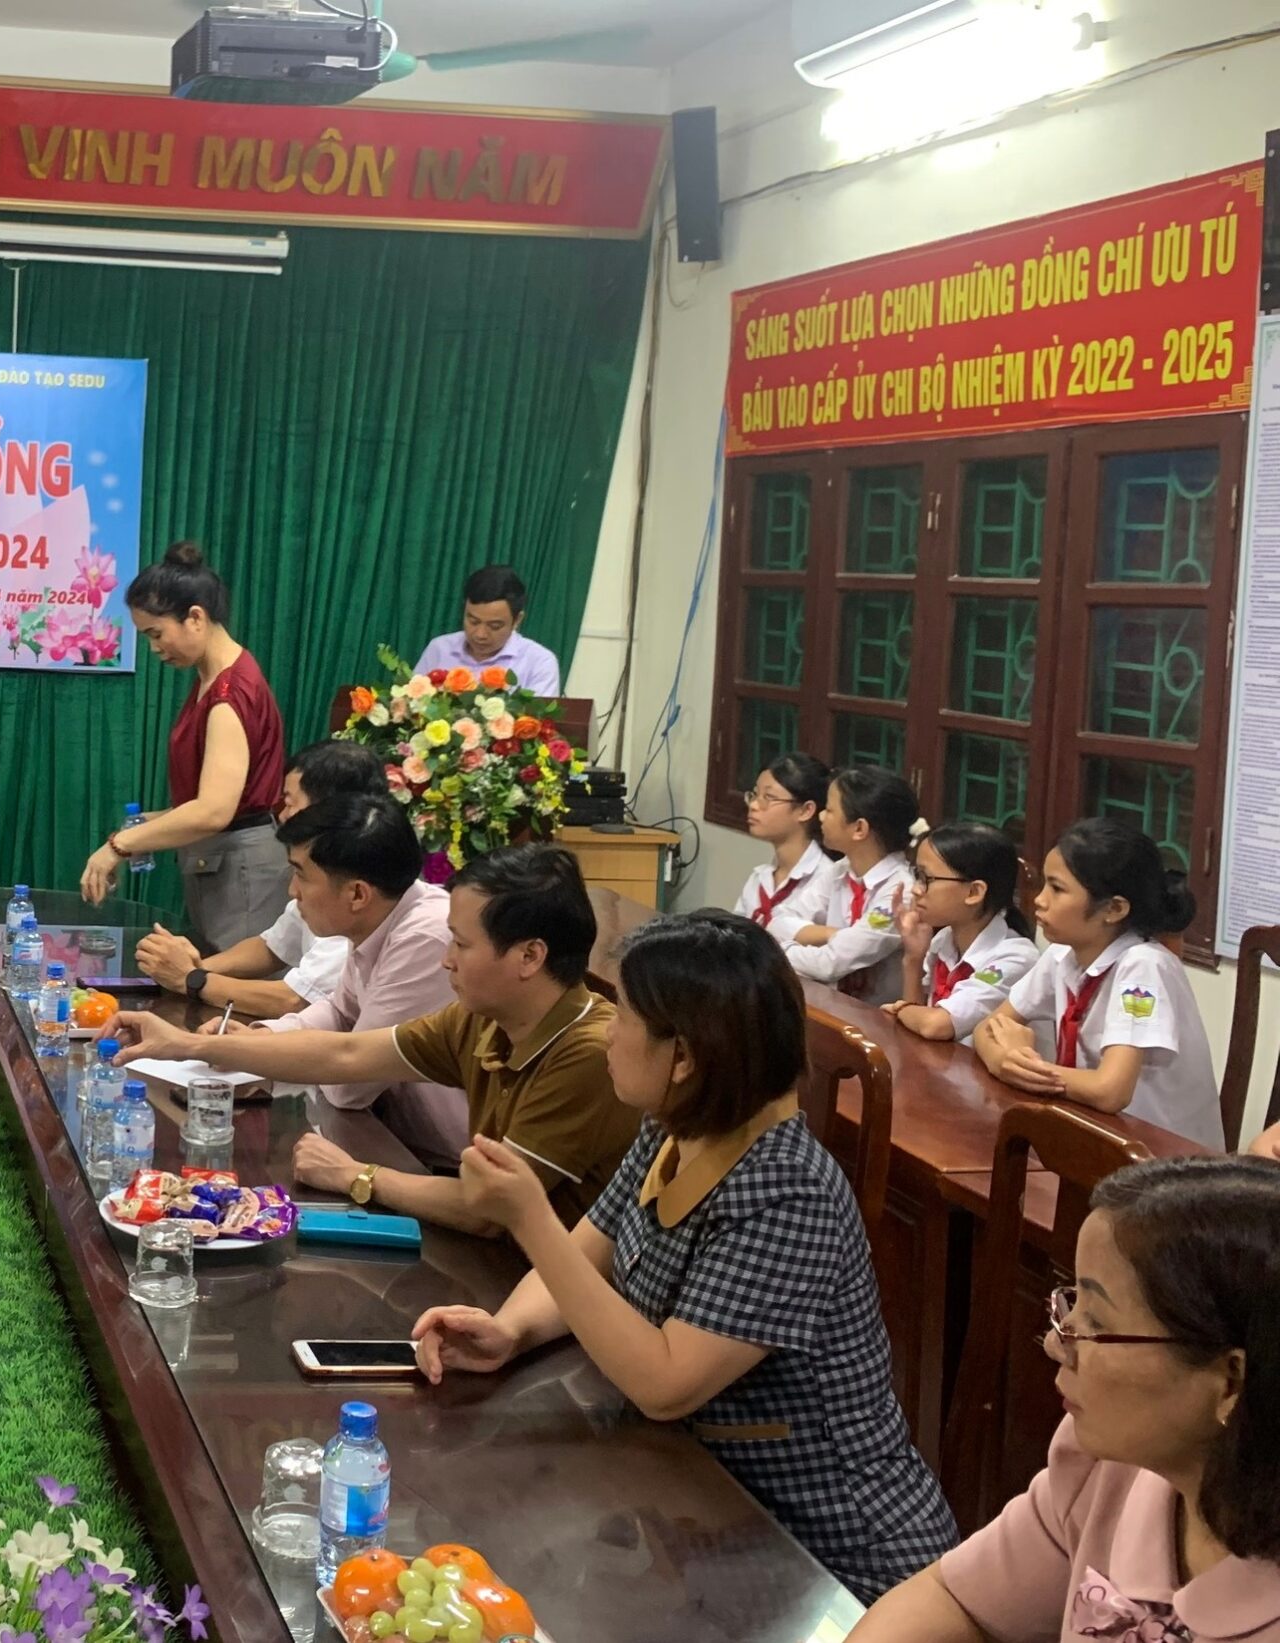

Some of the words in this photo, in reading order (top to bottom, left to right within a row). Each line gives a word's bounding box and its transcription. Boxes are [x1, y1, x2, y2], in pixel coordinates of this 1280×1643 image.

[20, 123, 174, 189] VINH
[197, 128, 396, 197] MUÔN
[413, 136, 568, 207] NĂM
[745, 308, 789, 361] SÁNG
[793, 288, 838, 352] SUỐT
[840, 291, 874, 351] LỰA
[880, 280, 934, 342] CHỌN
[939, 260, 1015, 326] NHỮNG
[1021, 236, 1090, 311] ĐỒNG
[1097, 222, 1146, 296] CHÍ
[1151, 222, 1192, 288] ƯU
[1200, 201, 1238, 278] TÚ
[34, 371, 64, 388] TẠO
[69, 373, 106, 389] SEDU
[777, 375, 809, 429] VÀO
[812, 363, 848, 425] CẤP
[852, 360, 877, 421] ỦY
[882, 368, 914, 418] CHI
[919, 353, 946, 422] BỘ
[951, 344, 1025, 416] NHIỆM
[1031, 334, 1064, 401] KỲ
[1067, 335, 1135, 396] 2022
[1162, 320, 1234, 386] 2025
[6, 590, 43, 605] năm
[46, 590, 87, 605] 2024
